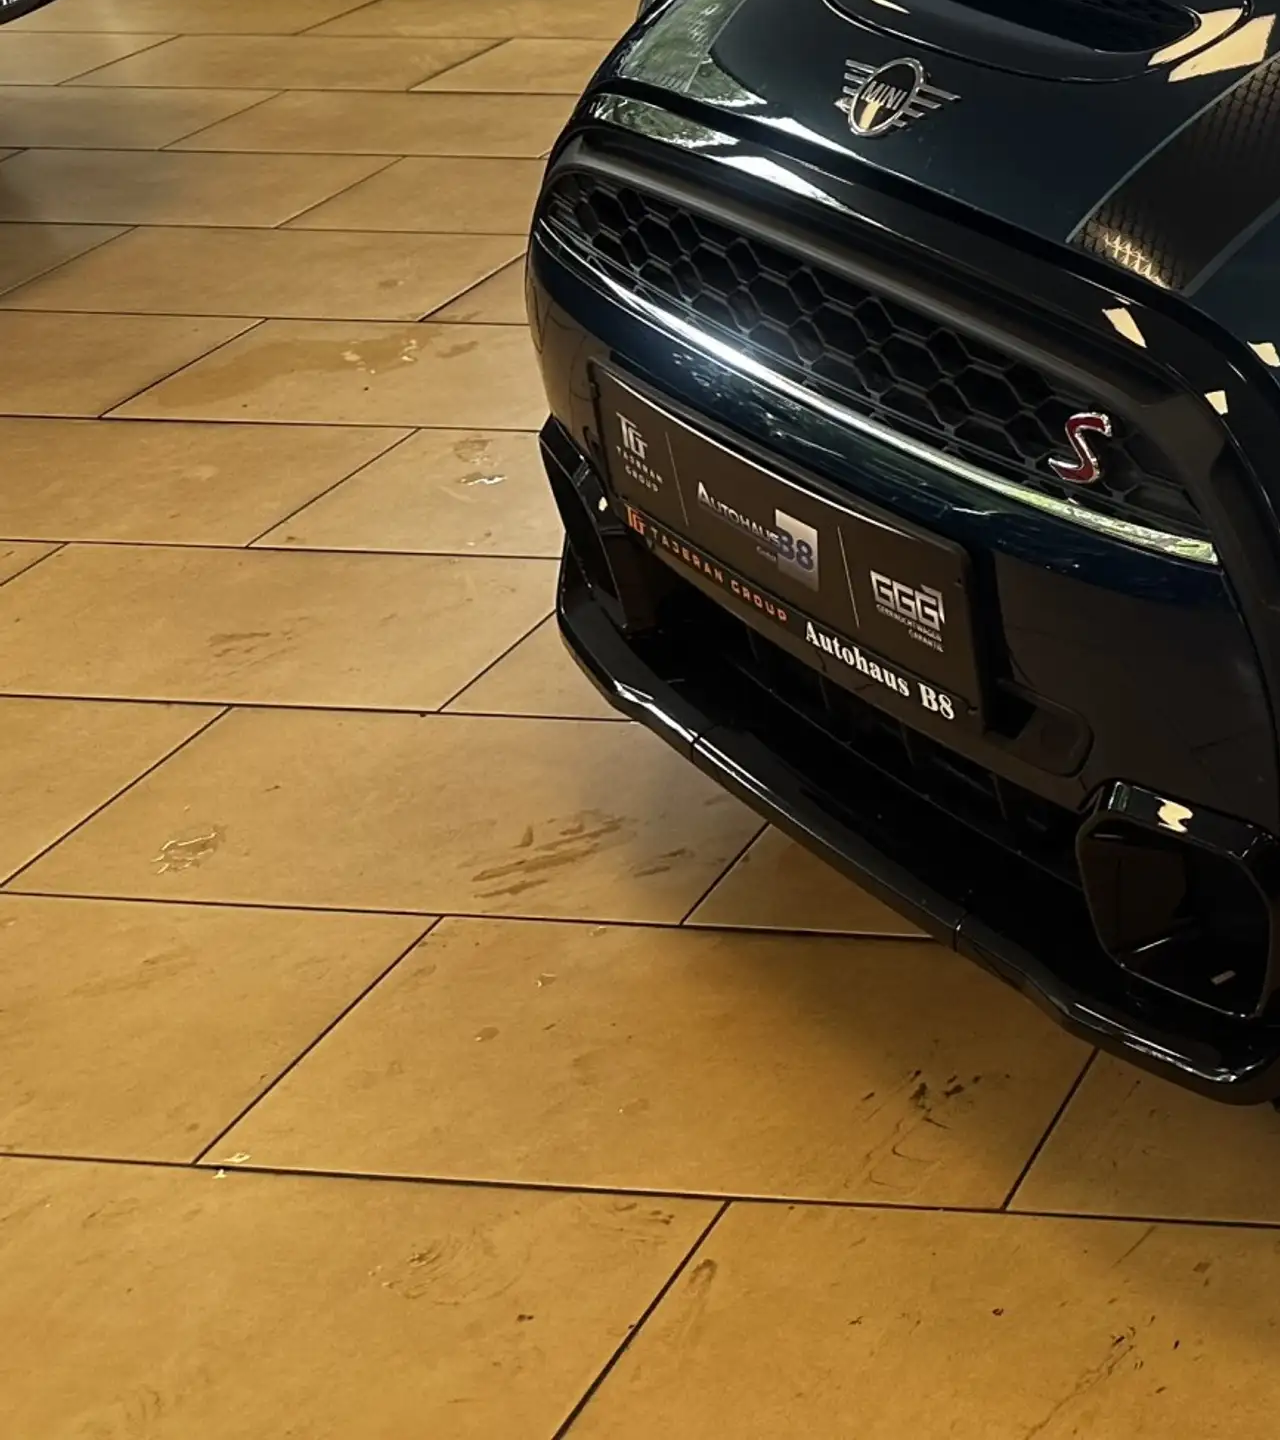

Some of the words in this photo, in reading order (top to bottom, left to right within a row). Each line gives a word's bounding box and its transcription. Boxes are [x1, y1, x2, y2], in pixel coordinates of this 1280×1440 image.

[861, 80, 909, 111] MINI
[1047, 410, 1112, 484] S
[869, 569, 946, 632] GGG
[730, 580, 787, 622] GROUP
[805, 620, 910, 697] Autohaus
[917, 681, 955, 720] B8
